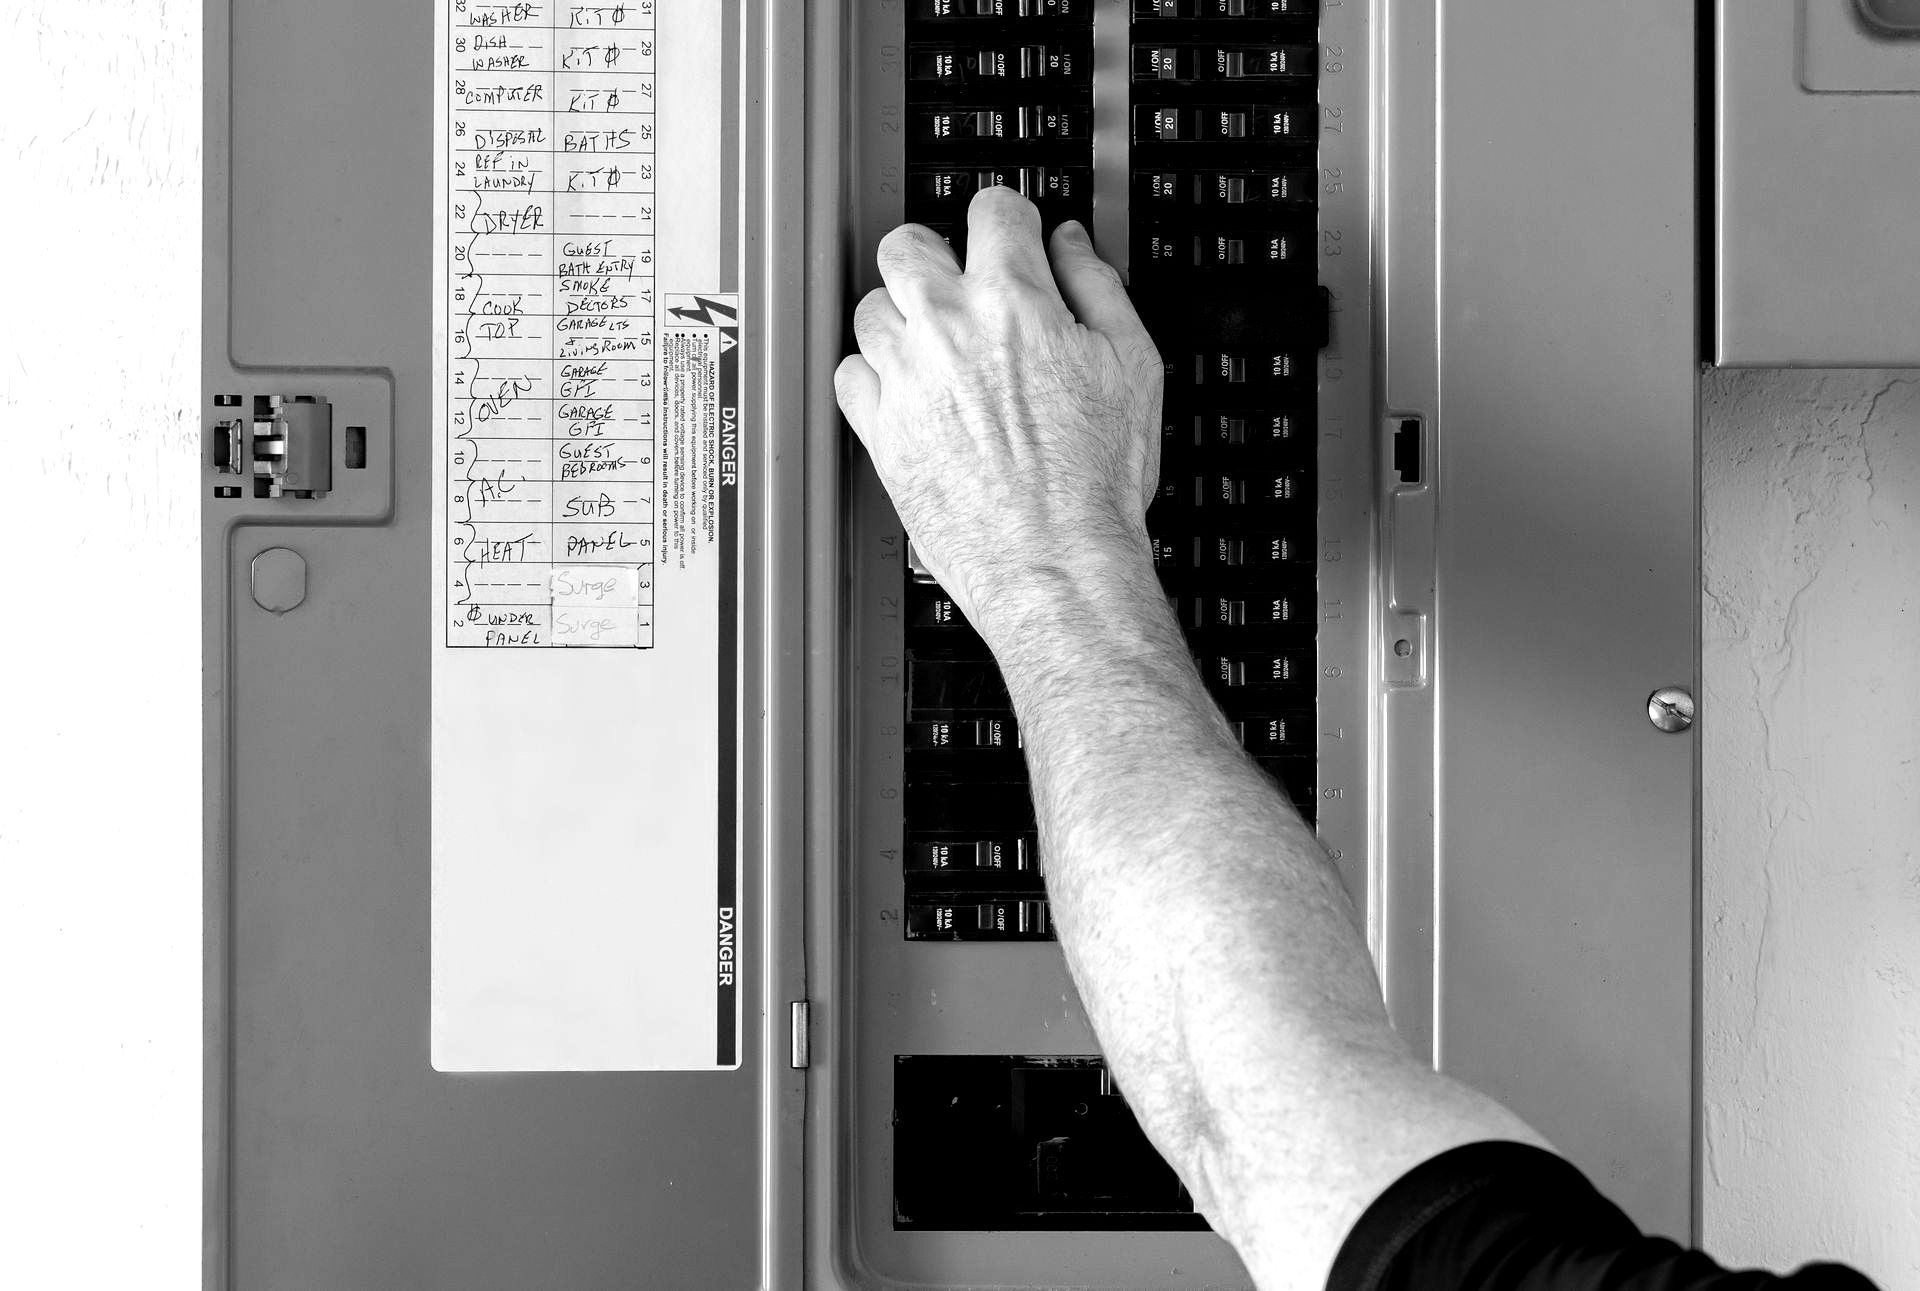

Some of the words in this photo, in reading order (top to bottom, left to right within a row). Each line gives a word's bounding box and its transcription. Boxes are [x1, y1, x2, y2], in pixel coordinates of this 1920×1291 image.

[455, 0, 466, 13] 32
[641, 0, 652, 15] 31
[469, 2, 539, 26] WASHER
[455, 38, 466, 53] 30
[641, 41, 652, 56] 29
[472, 54, 529, 70] WASHER
[945, 56, 952, 64] 10
[1050, 56, 1058, 67] 20
[1164, 57, 1172, 70] 20
[1270, 63, 1277, 71] 10
[1325, 47, 1344, 73] 29
[455, 80, 466, 94] 28
[641, 83, 652, 98] 27
[465, 85, 543, 104] COMPUTER
[942, 116, 950, 124] 10
[1048, 116, 1056, 127] 20
[1166, 117, 1173, 129] 20
[1324, 107, 1343, 133] 27
[455, 121, 466, 137] 26
[641, 125, 652, 140] 25
[1274, 125, 1281, 134] 10
[564, 129, 631, 152] BATHS
[455, 162, 466, 176] 24
[641, 165, 652, 180] 23
[473, 172, 535, 195] LAUNDRY
[944, 176, 951, 184] 10
[1050, 177, 1058, 188] 20
[1324, 168, 1343, 194] 25
[1164, 183, 1172, 194] 20
[1272, 189, 1279, 197] 10
[455, 204, 465, 219] 22
[641, 207, 651, 221] 21
[484, 206, 544, 235] DRYER
[562, 240, 613, 257] GUEST
[1164, 245, 1172, 256] 20
[1324, 230, 1342, 257] 23
[455, 245, 465, 261] 20
[641, 249, 651, 263] 19
[1271, 251, 1278, 259] 10
[558, 262, 590, 278] BATH
[454, 286, 465, 301] 18
[559, 278, 610, 295] SMOKE
[641, 289, 651, 303] 17
[482, 297, 524, 315] COOK
[480, 317, 519, 341] TOP
[557, 316, 607, 331] GARAGE
[609, 321, 630, 331] LTS
[454, 329, 465, 343] 16
[640, 331, 650, 345] 15
[560, 362, 608, 379] GARAGE
[454, 371, 464, 385] 14
[640, 373, 650, 387] 13
[478, 375, 532, 422] OVEN
[709, 393, 715, 402] OF
[454, 411, 464, 425] 12
[558, 404, 614, 420] GARAGE
[640, 412, 650, 426] 11
[1273, 429, 1280, 437] 10
[559, 442, 616, 459] GUEST
[722, 407, 736, 486] DANGER
[454, 451, 464, 465] 10
[640, 456, 650, 464] 9
[562, 457, 626, 480] BEDROOMS
[454, 495, 464, 503] 8
[708, 489, 715, 500] OR
[562, 492, 616, 518] SUB
[454, 537, 464, 545] 6
[567, 530, 632, 556] PANEL
[481, 533, 534, 570] HEAT
[1164, 547, 1172, 558] 15
[1272, 551, 1279, 559] 10
[453, 580, 464, 588] 4
[558, 571, 617, 600] Surge
[944, 601, 951, 609] 10
[453, 620, 464, 628] 2
[488, 612, 534, 625] UNDER
[555, 613, 617, 640] Surge
[486, 630, 541, 647] PANEL
[1273, 671, 1280, 679] 10
[1270, 729, 1277, 740] 10
[941, 846, 948, 855] 10
[945, 909, 952, 917] 10
[719, 907, 734, 986] DANGER
